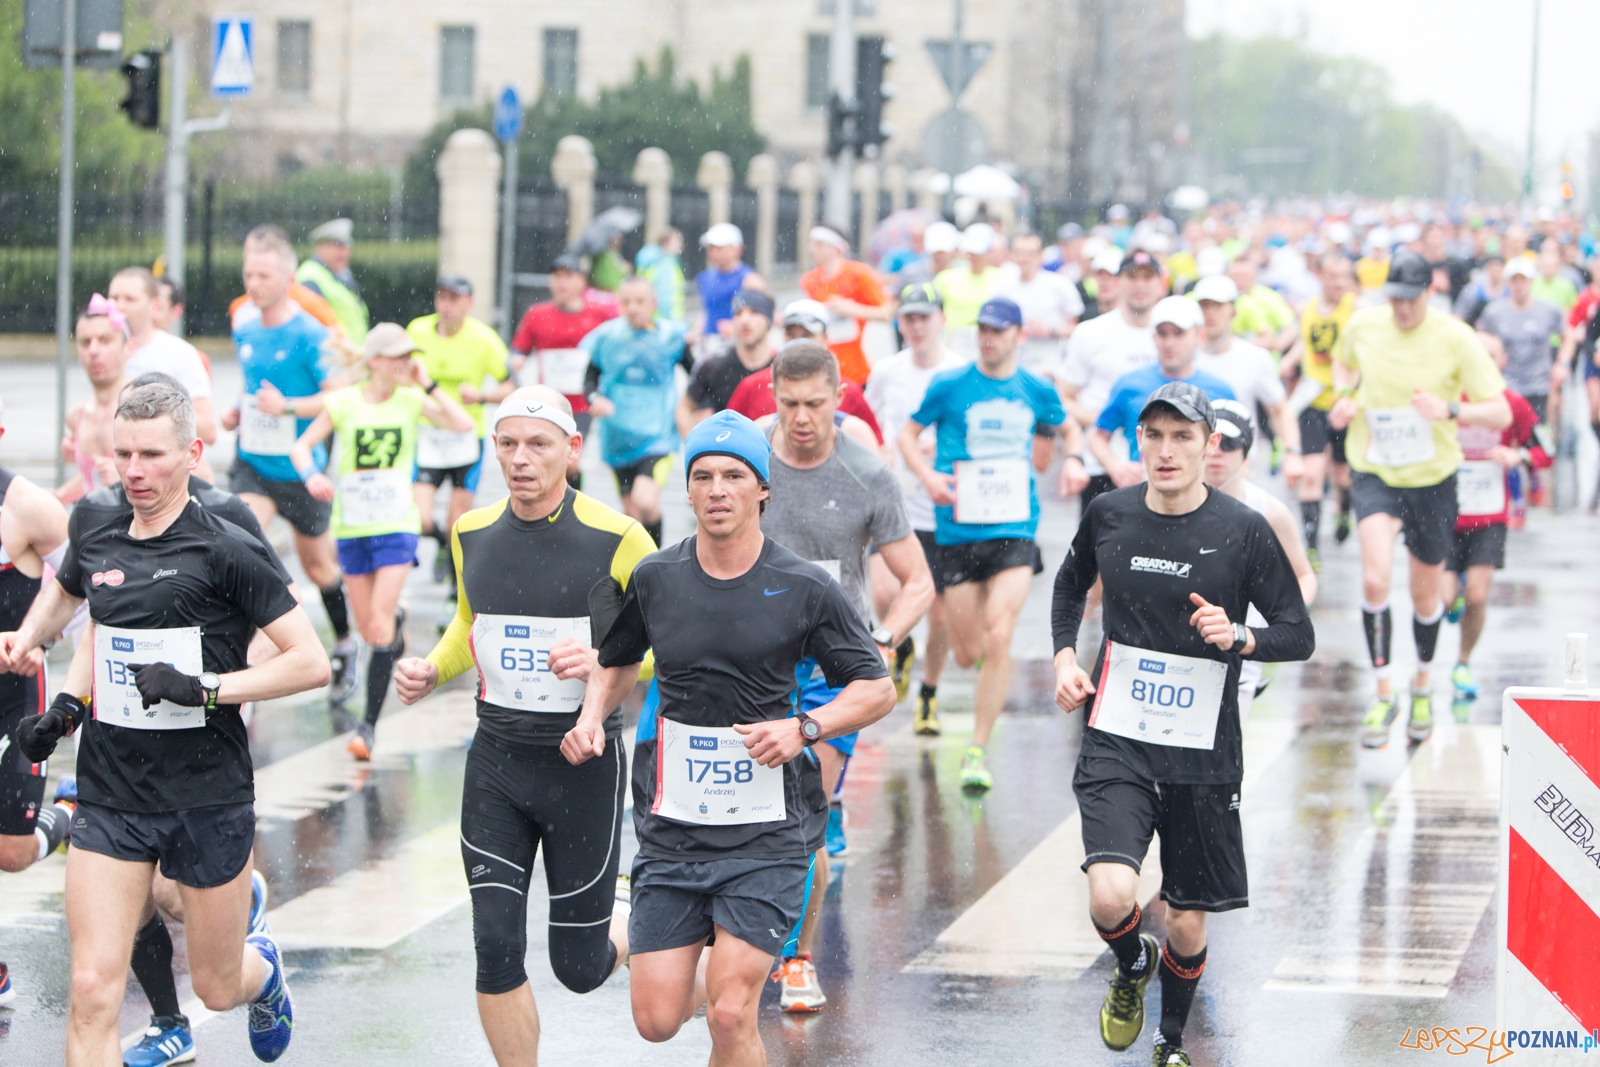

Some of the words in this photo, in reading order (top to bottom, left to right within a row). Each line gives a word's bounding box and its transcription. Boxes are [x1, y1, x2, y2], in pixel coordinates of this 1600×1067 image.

[1130, 555, 1178, 571] CREATON
[521, 675, 542, 683] Jacek
[1131, 679, 1195, 708] 8100
[692, 739, 714, 748] 9.PKO
[685, 758, 753, 784] 1758
[703, 788, 736, 796] Andrzej
[726, 807, 740, 815] 4F
